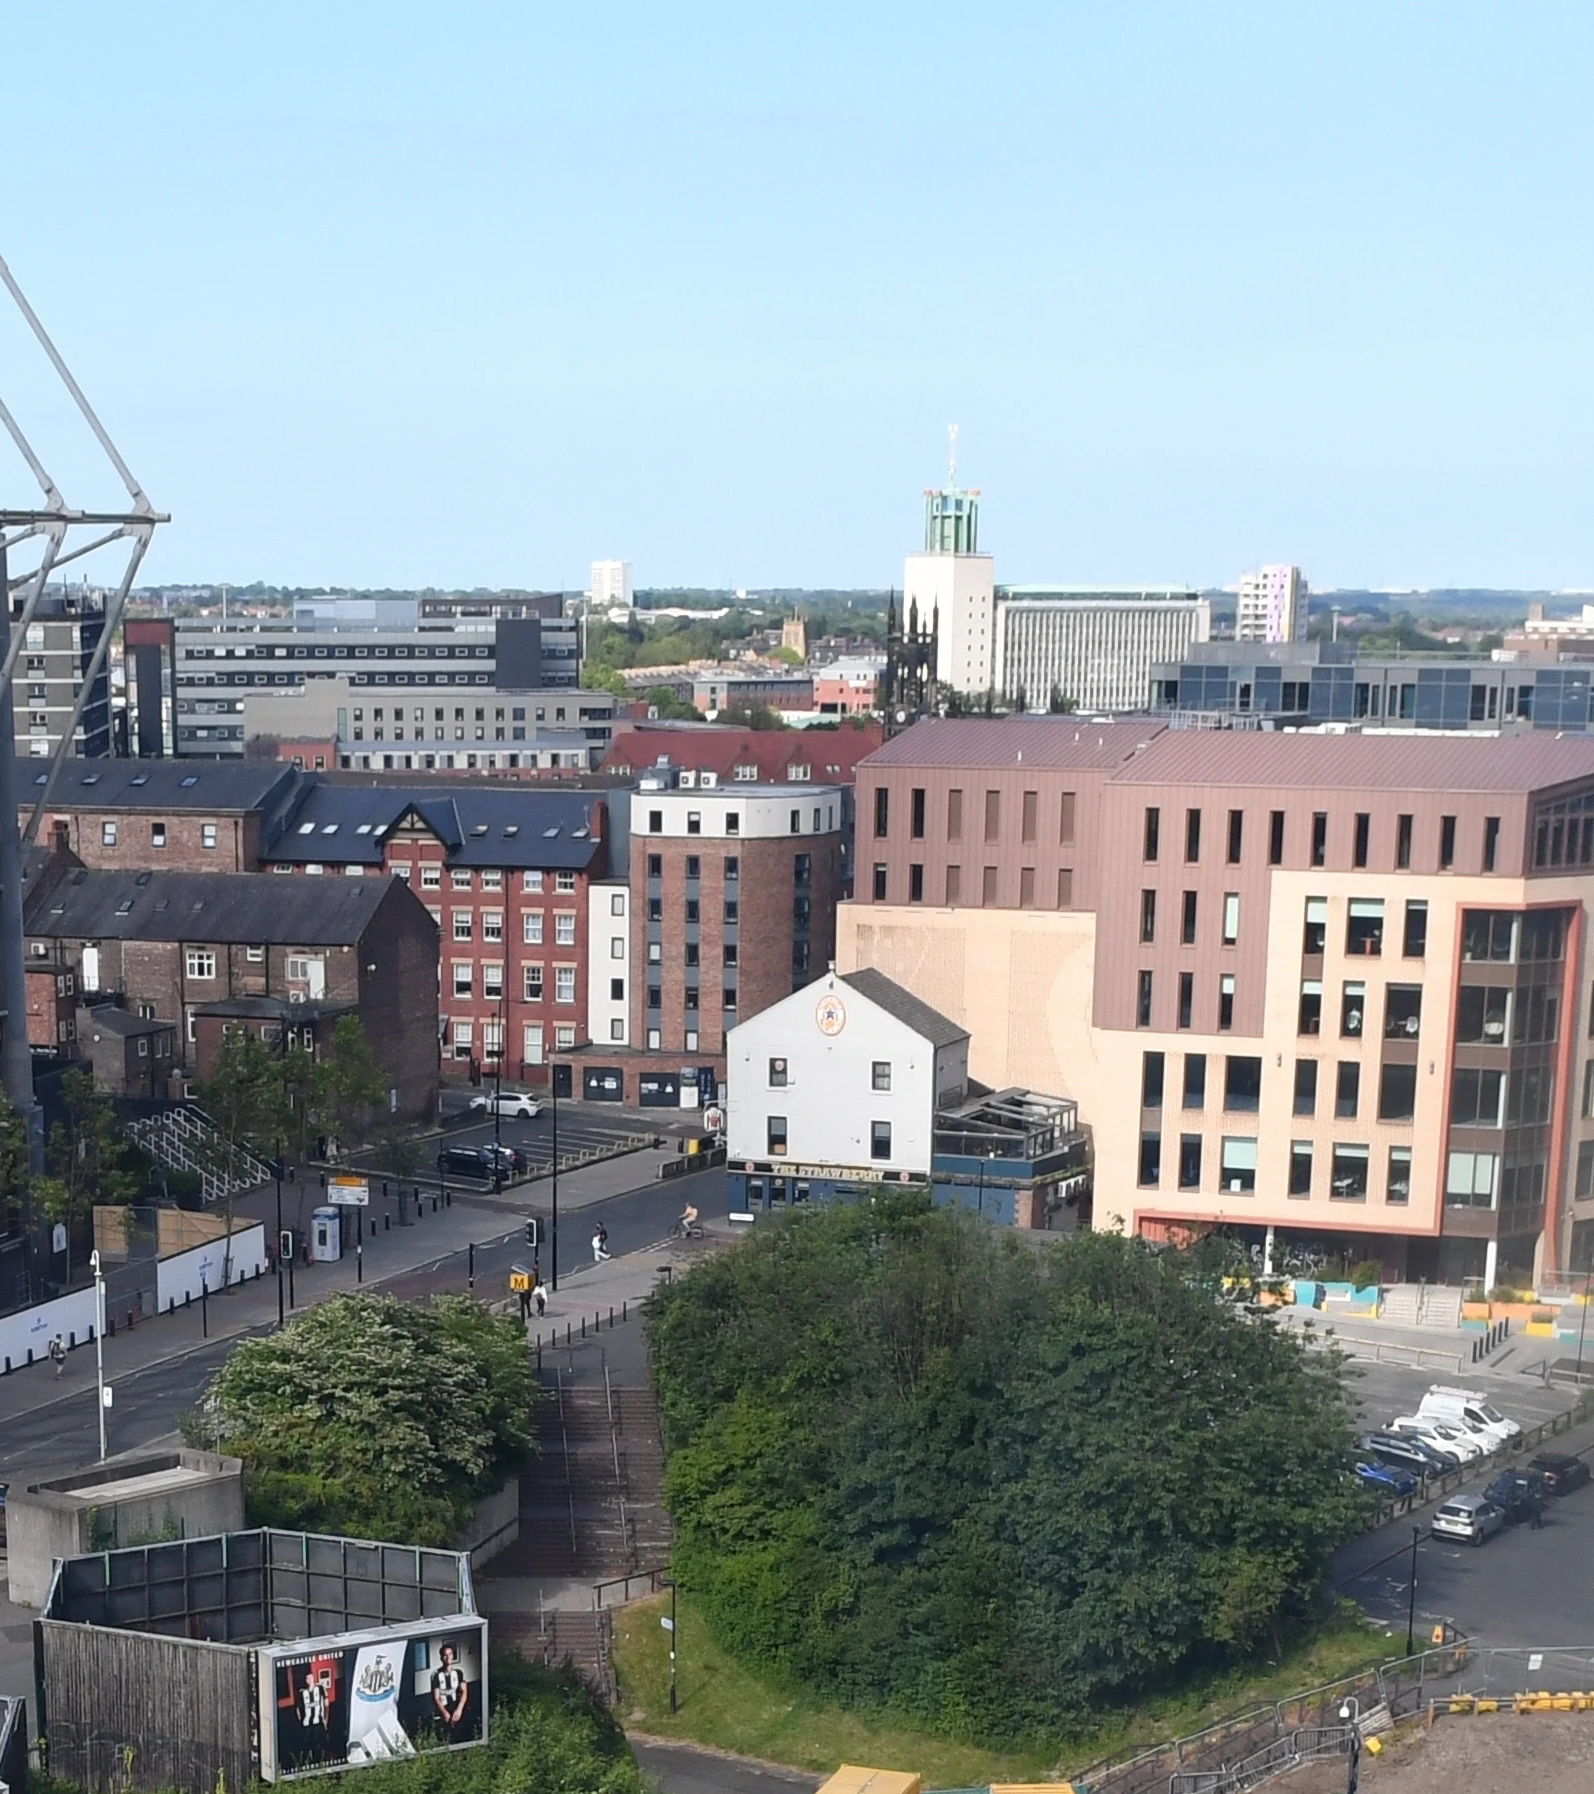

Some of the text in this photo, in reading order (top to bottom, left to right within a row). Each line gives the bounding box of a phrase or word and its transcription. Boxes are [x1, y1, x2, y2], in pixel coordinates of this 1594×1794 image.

[772, 1163, 884, 1181] THE STRAWBERRY
[276, 1650, 344, 1668] NEWCASTLE UNITED
